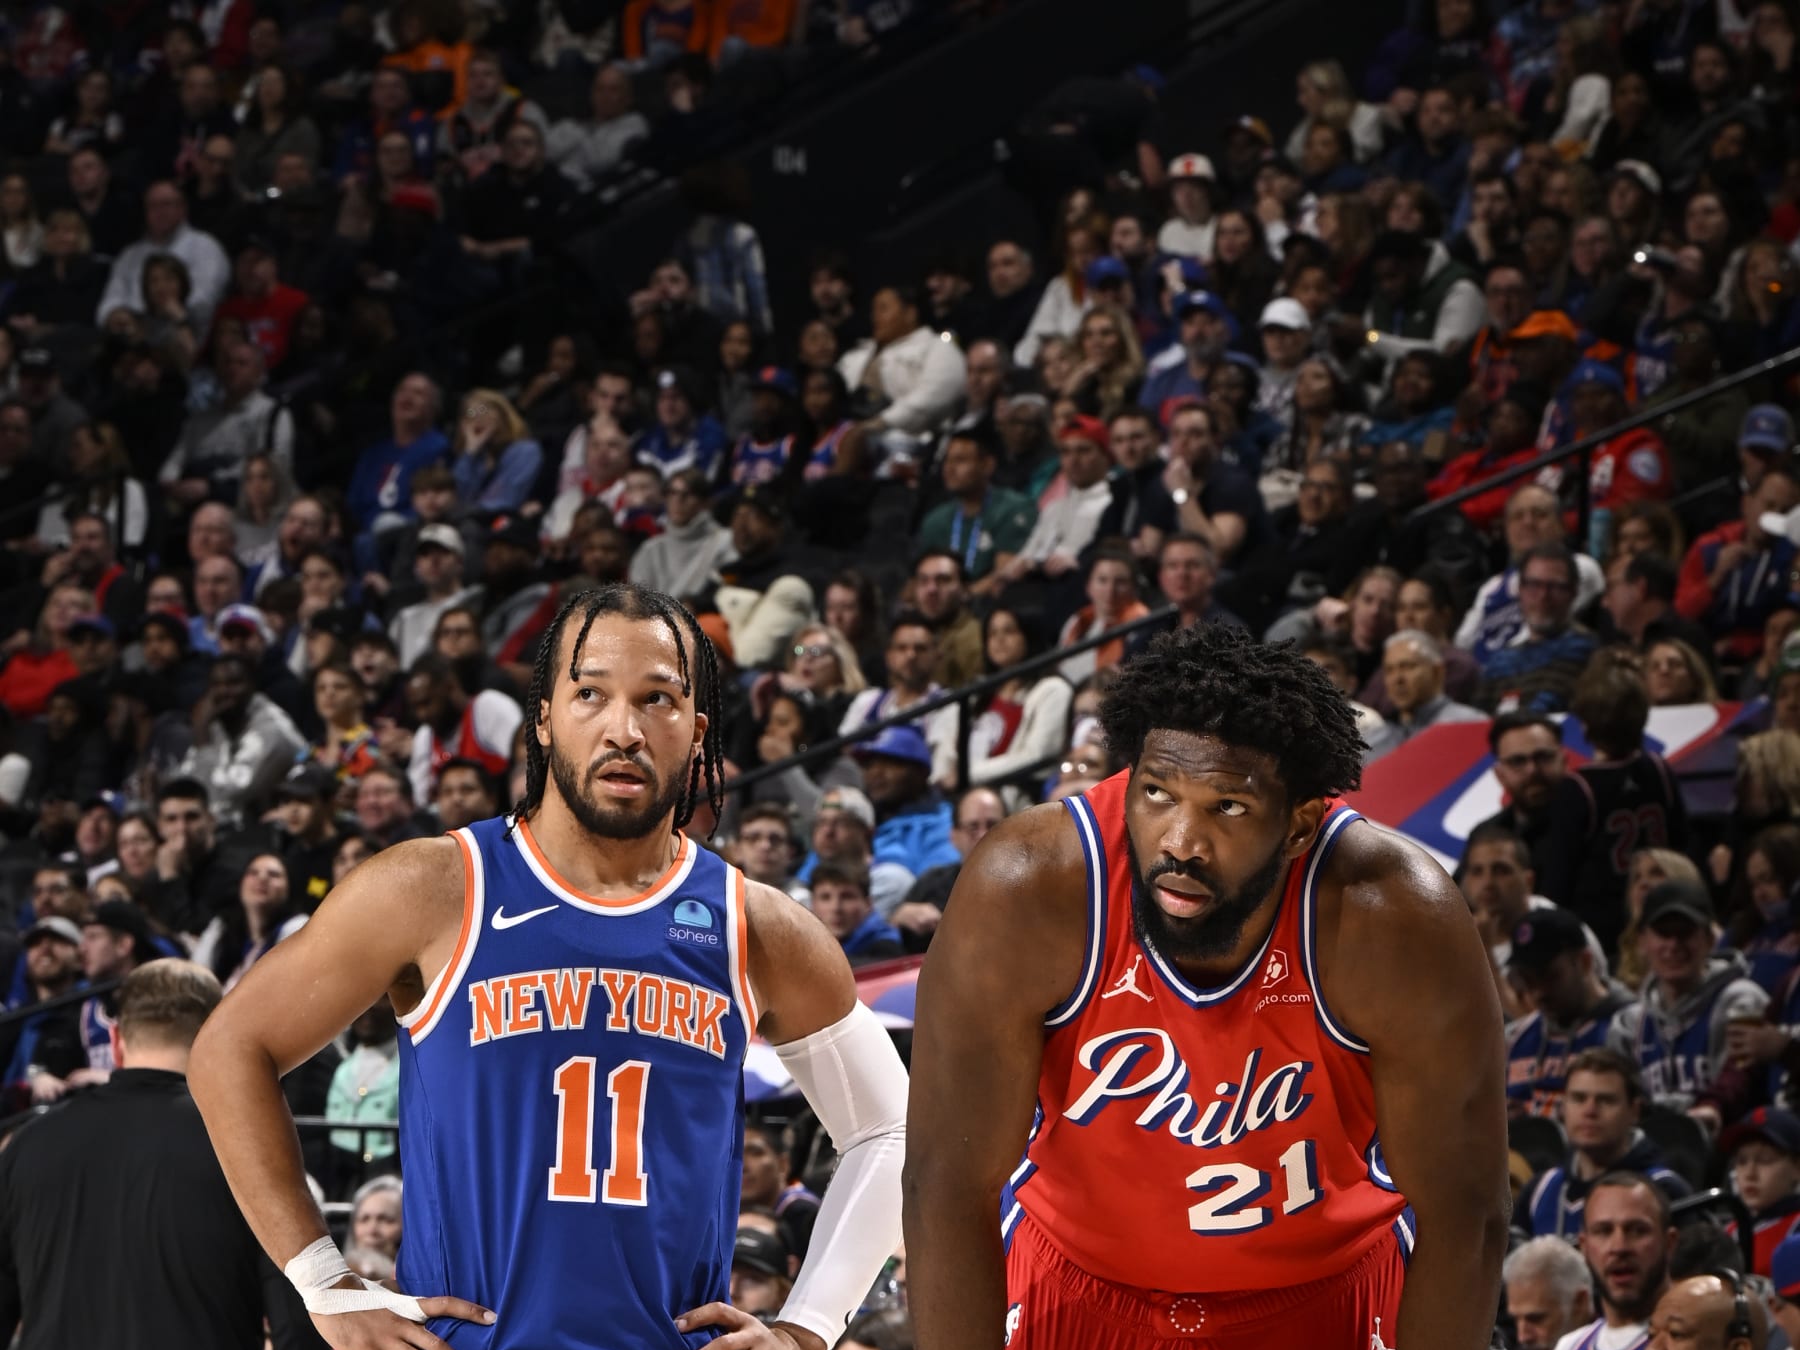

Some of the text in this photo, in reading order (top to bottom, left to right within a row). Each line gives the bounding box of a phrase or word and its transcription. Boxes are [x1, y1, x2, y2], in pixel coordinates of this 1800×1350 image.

[669, 927, 718, 945] sphere
[469, 968, 730, 1060] NEW YORK
[1254, 993, 1311, 1013] pto.com
[547, 1055, 651, 1206] 11
[1062, 1027, 1314, 1149] Phila
[1185, 1139, 1325, 1237] 21
